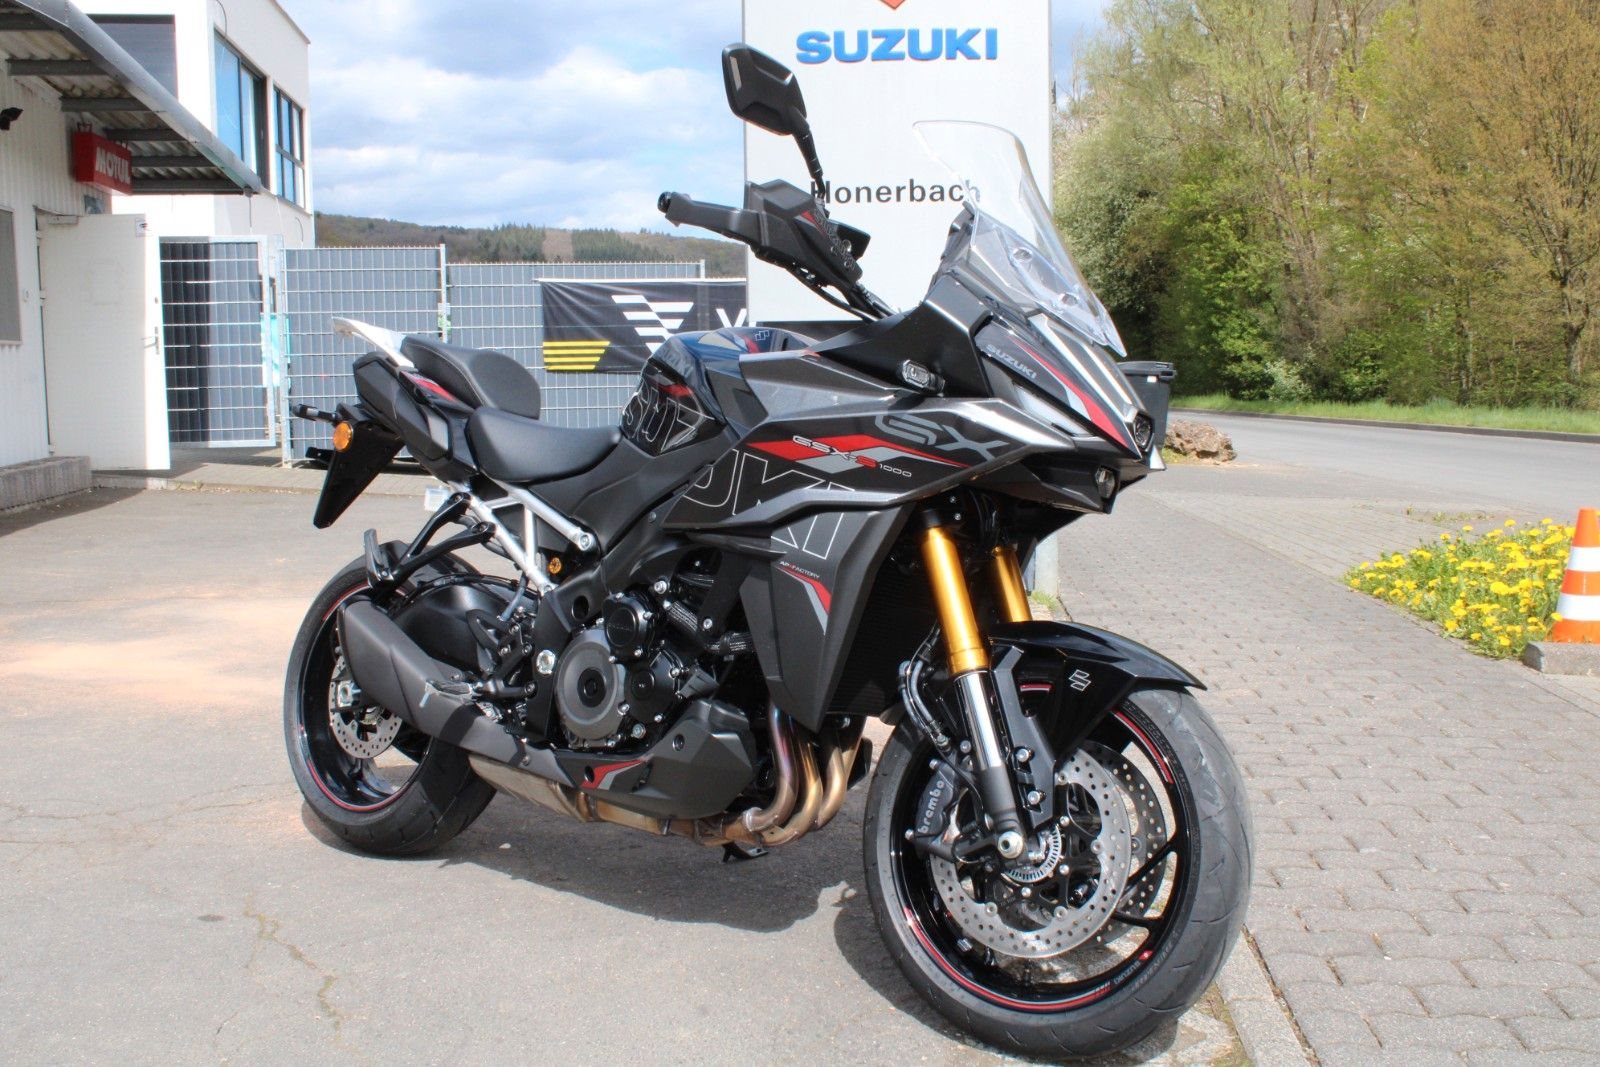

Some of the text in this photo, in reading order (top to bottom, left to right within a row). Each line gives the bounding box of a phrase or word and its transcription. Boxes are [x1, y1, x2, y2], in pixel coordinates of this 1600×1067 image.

[796, 28, 998, 64] SUZUKI
[95, 146, 131, 185] MOTUL
[810, 178, 981, 204] Honerbach
[986, 344, 1037, 379] SUZUKI
[917, 780, 945, 834] brembo
